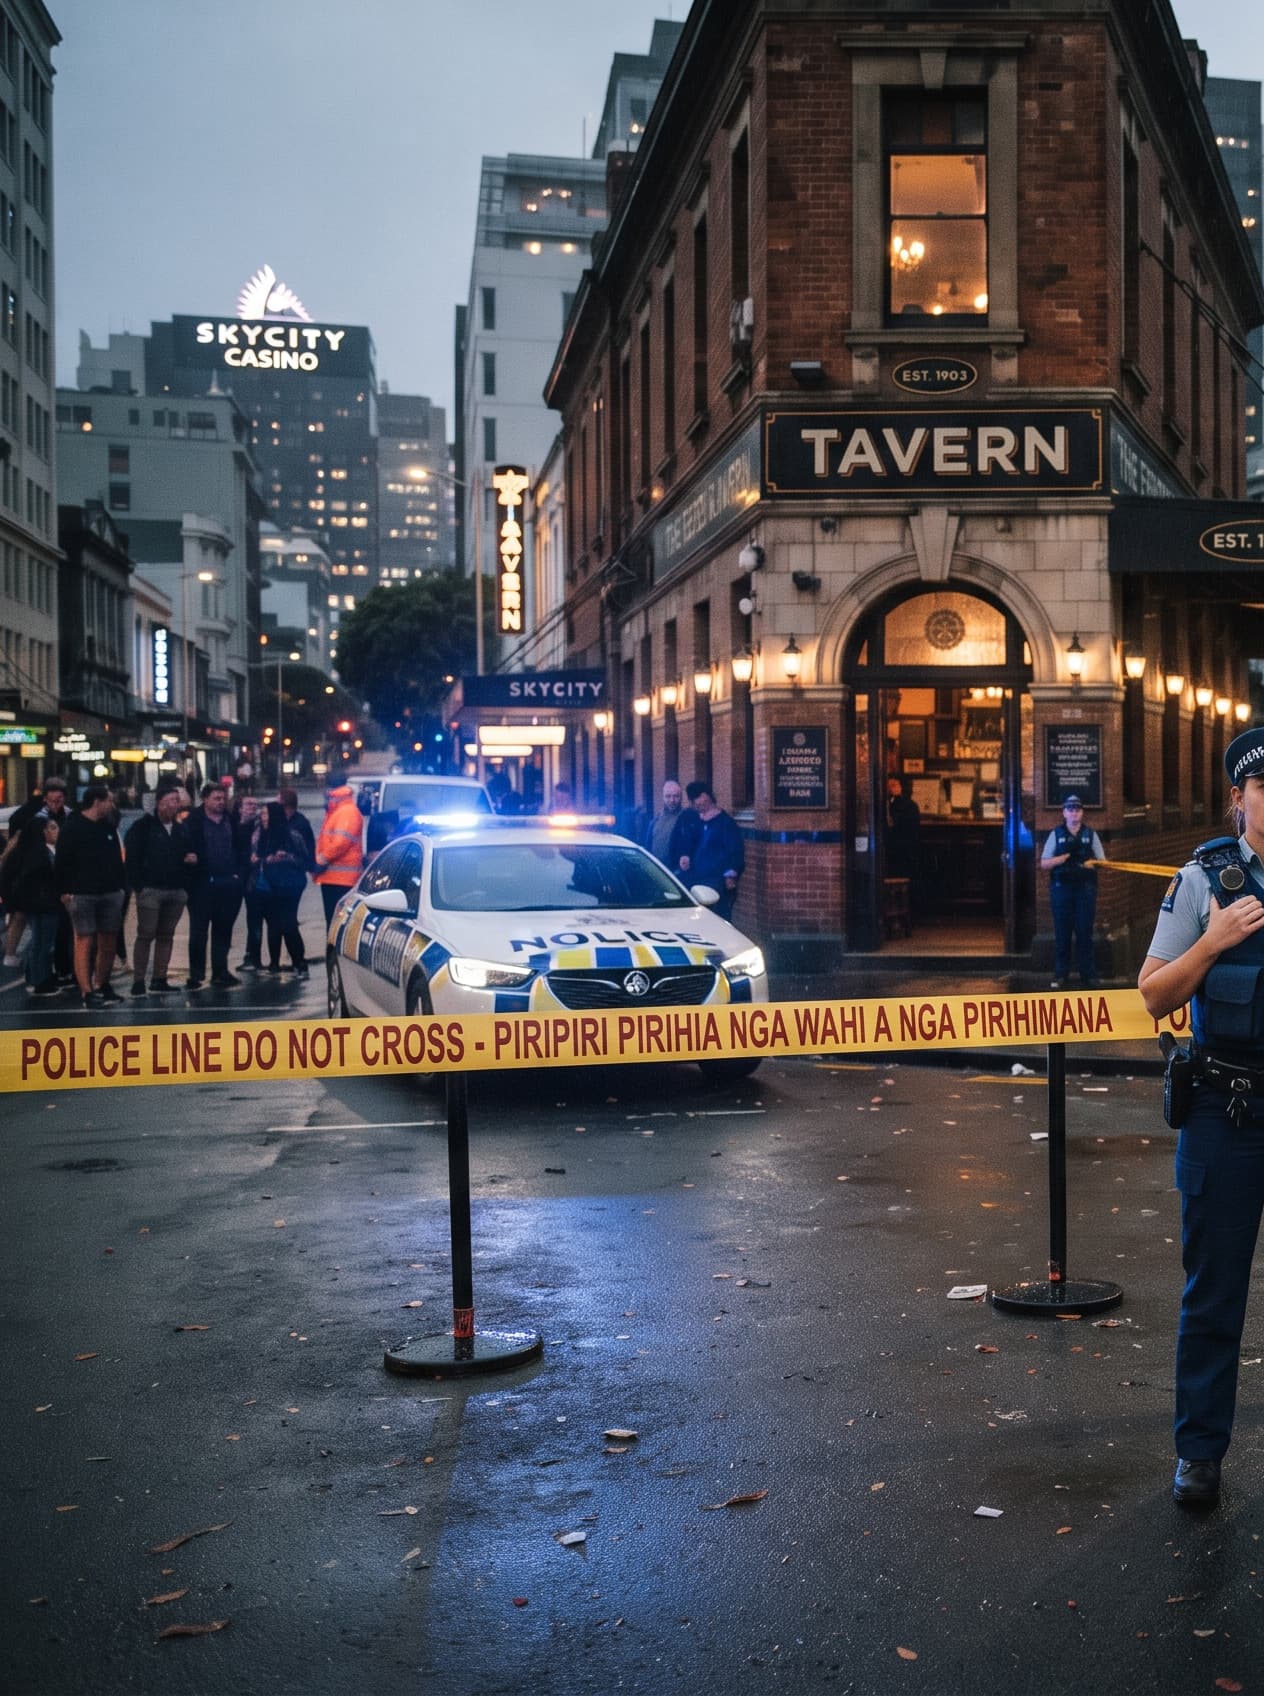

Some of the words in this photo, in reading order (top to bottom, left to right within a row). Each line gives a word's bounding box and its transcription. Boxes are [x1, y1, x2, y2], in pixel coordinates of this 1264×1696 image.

[196, 322, 345, 351] SKYCITY
[224, 347, 319, 371] CASINO
[902, 370, 932, 381] EST.
[936, 370, 967, 381] 1903
[801, 425, 1069, 478] TAVERN
[1213, 533, 1252, 548] EST.
[509, 682, 603, 697] SKYCITY
[22, 1036, 141, 1080] POLICE
[152, 1031, 222, 1074] LINE
[233, 1029, 278, 1071] DO
[288, 1027, 351, 1069] NOT
[360, 1022, 465, 1066] CROSS
[494, 1017, 608, 1060] PIRIPIRI
[618, 1012, 723, 1054] PIRIHIA
[730, 1009, 790, 1049] NGA
[794, 1006, 866, 1046] WAHI
[873, 1005, 893, 1042] A
[899, 1003, 957, 1041] NGA
[963, 996, 1114, 1038] PIRIHIMANA
